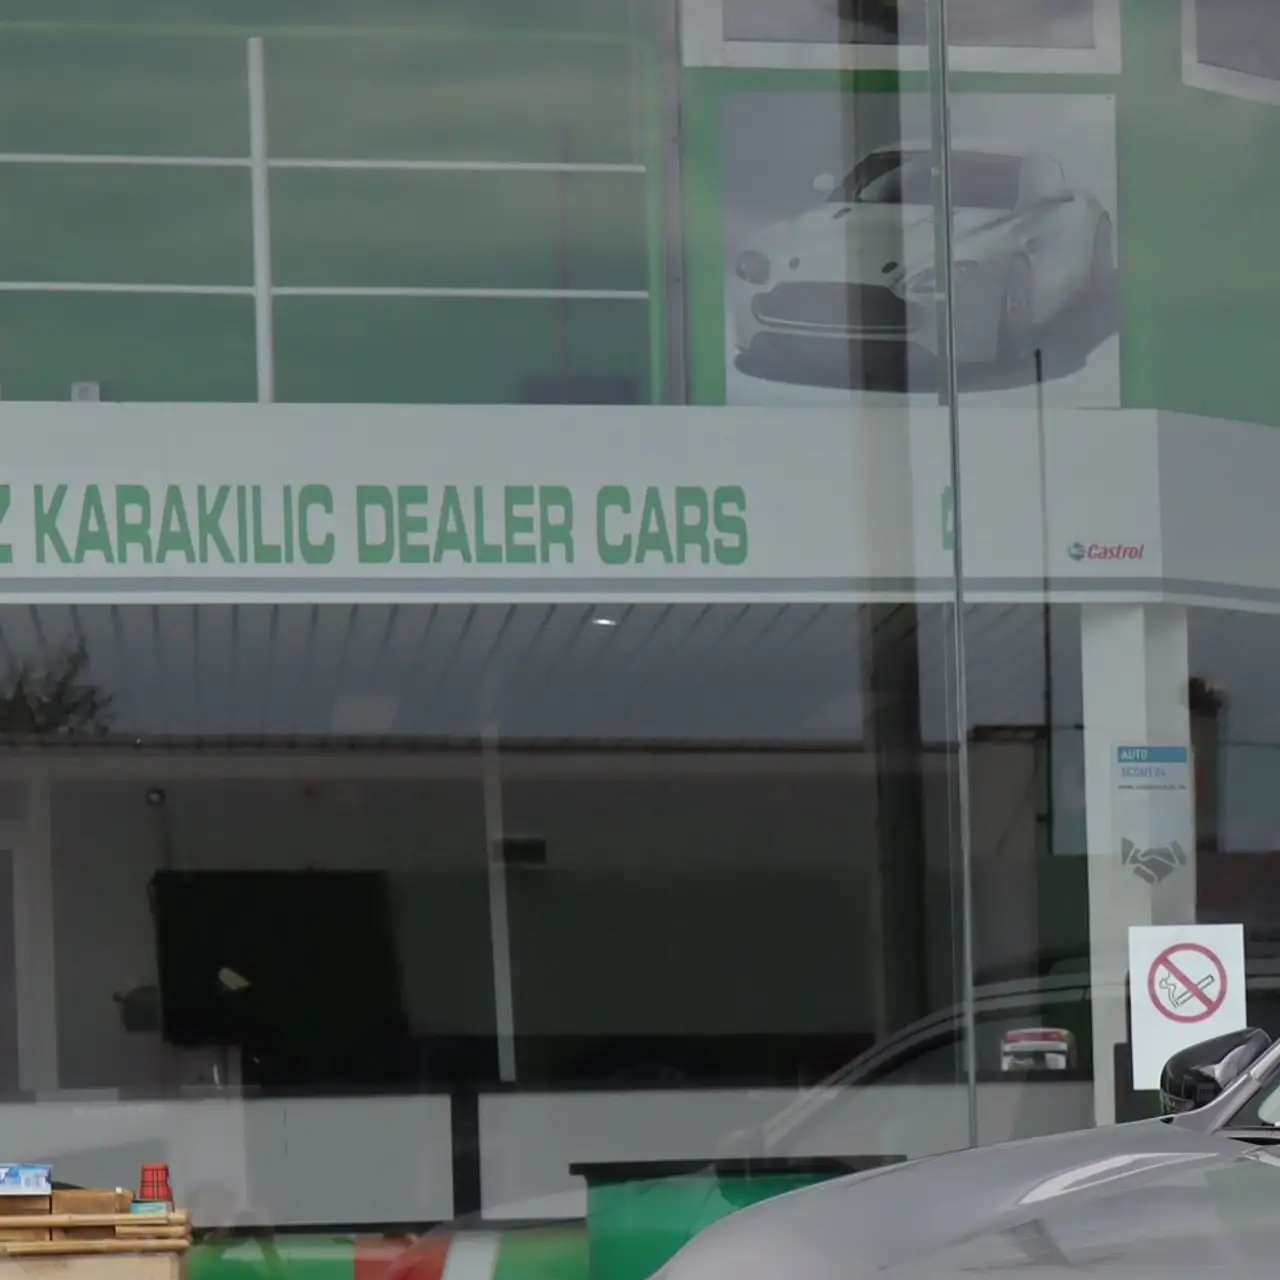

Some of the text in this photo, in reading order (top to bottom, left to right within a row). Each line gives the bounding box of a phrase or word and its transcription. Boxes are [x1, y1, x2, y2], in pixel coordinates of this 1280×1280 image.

[33, 483, 335, 565] KARAKILIC
[356, 484, 574, 565] DEALER
[596, 484, 749, 566] CARS
[1087, 543, 1145, 560] Castrol
[1120, 748, 1148, 761] AUTO
